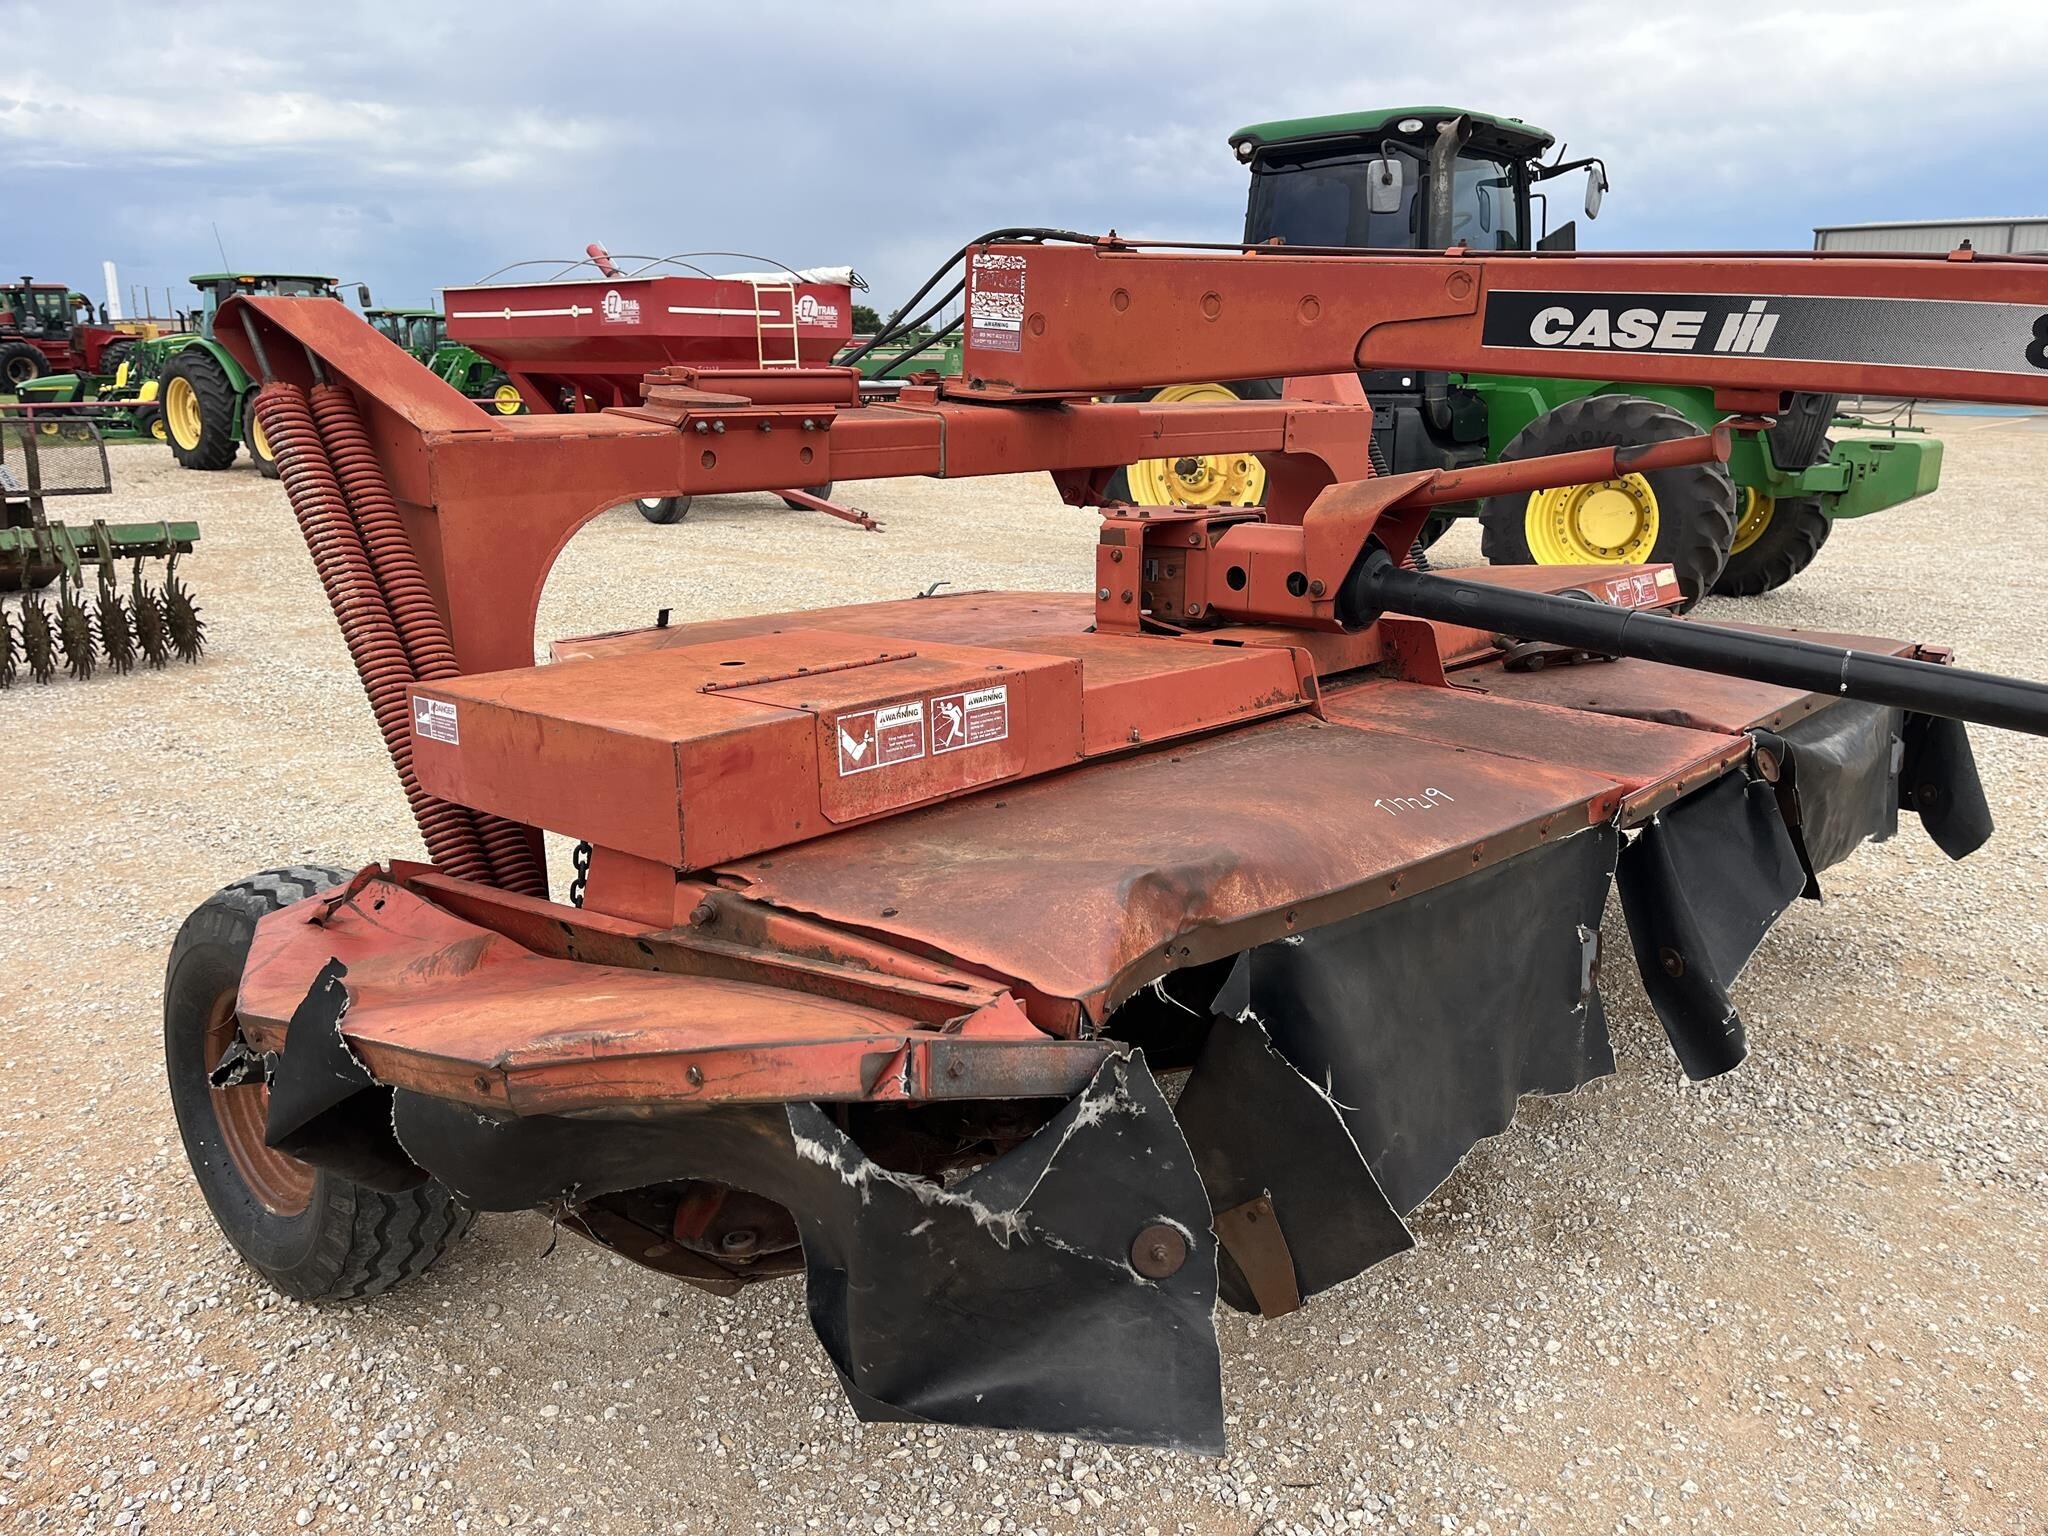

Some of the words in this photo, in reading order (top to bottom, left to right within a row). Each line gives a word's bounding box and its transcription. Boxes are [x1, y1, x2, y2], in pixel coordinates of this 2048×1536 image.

[608, 295, 618, 314] EZ
[802, 300, 814, 317] EZ
[1529, 306, 1707, 350] CASE
[973, 692, 1003, 705] WARNING
[885, 708, 919, 722] WARNING
